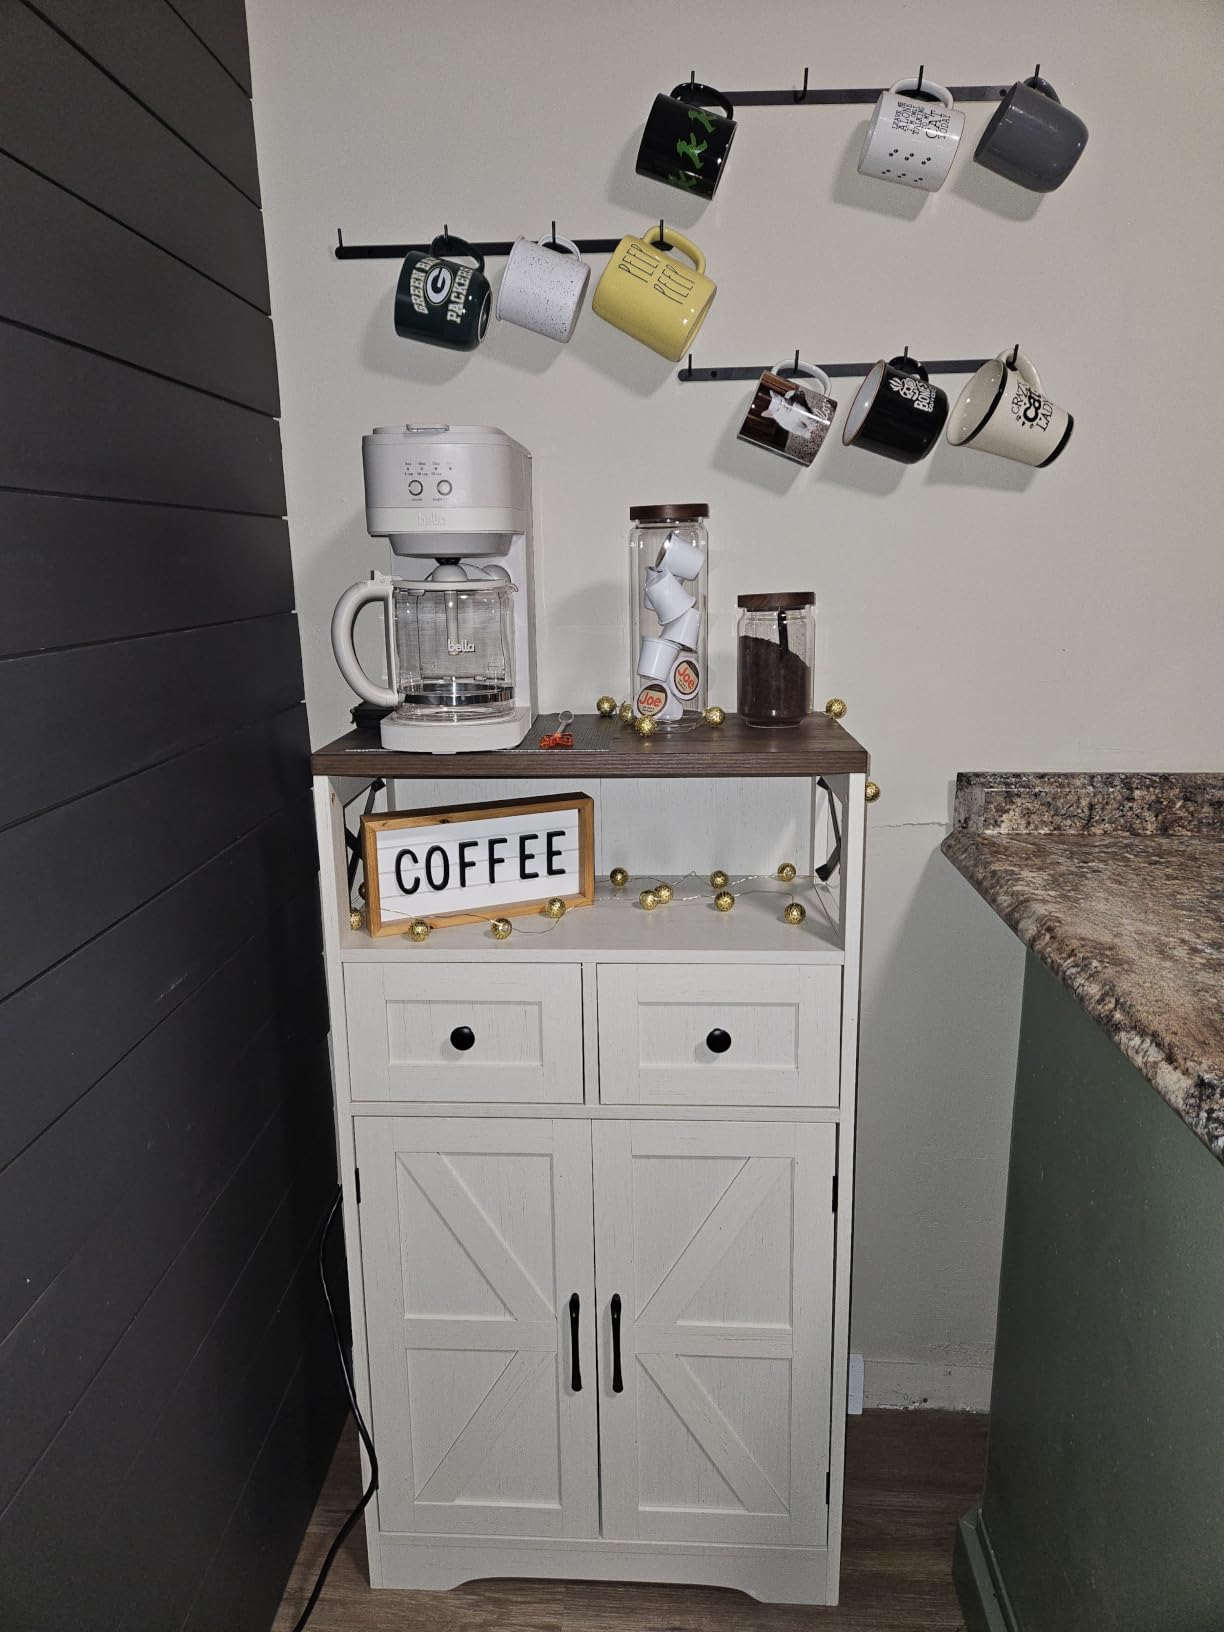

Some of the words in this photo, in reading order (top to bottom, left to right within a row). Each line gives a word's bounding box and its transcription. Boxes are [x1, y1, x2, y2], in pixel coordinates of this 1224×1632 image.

[898, 103, 912, 132] ALONE
[911, 106, 925, 135] TALKING
[925, 110, 943, 139] CAT
[938, 114, 951, 139] TODAY
[617, 242, 661, 283] PEEP
[410, 268, 429, 314] GREEN
[425, 265, 453, 304] G
[446, 265, 473, 324] PACKERS
[652, 263, 696, 305] PEEP
[913, 380, 930, 412] BONES
[1011, 379, 1028, 415] CRAZY
[1035, 396, 1054, 432] LADY
[447, 639, 476, 653] bella
[677, 667, 695, 690] Joe
[640, 691, 662, 708] Joe
[394, 830, 567, 896] COFFEE
